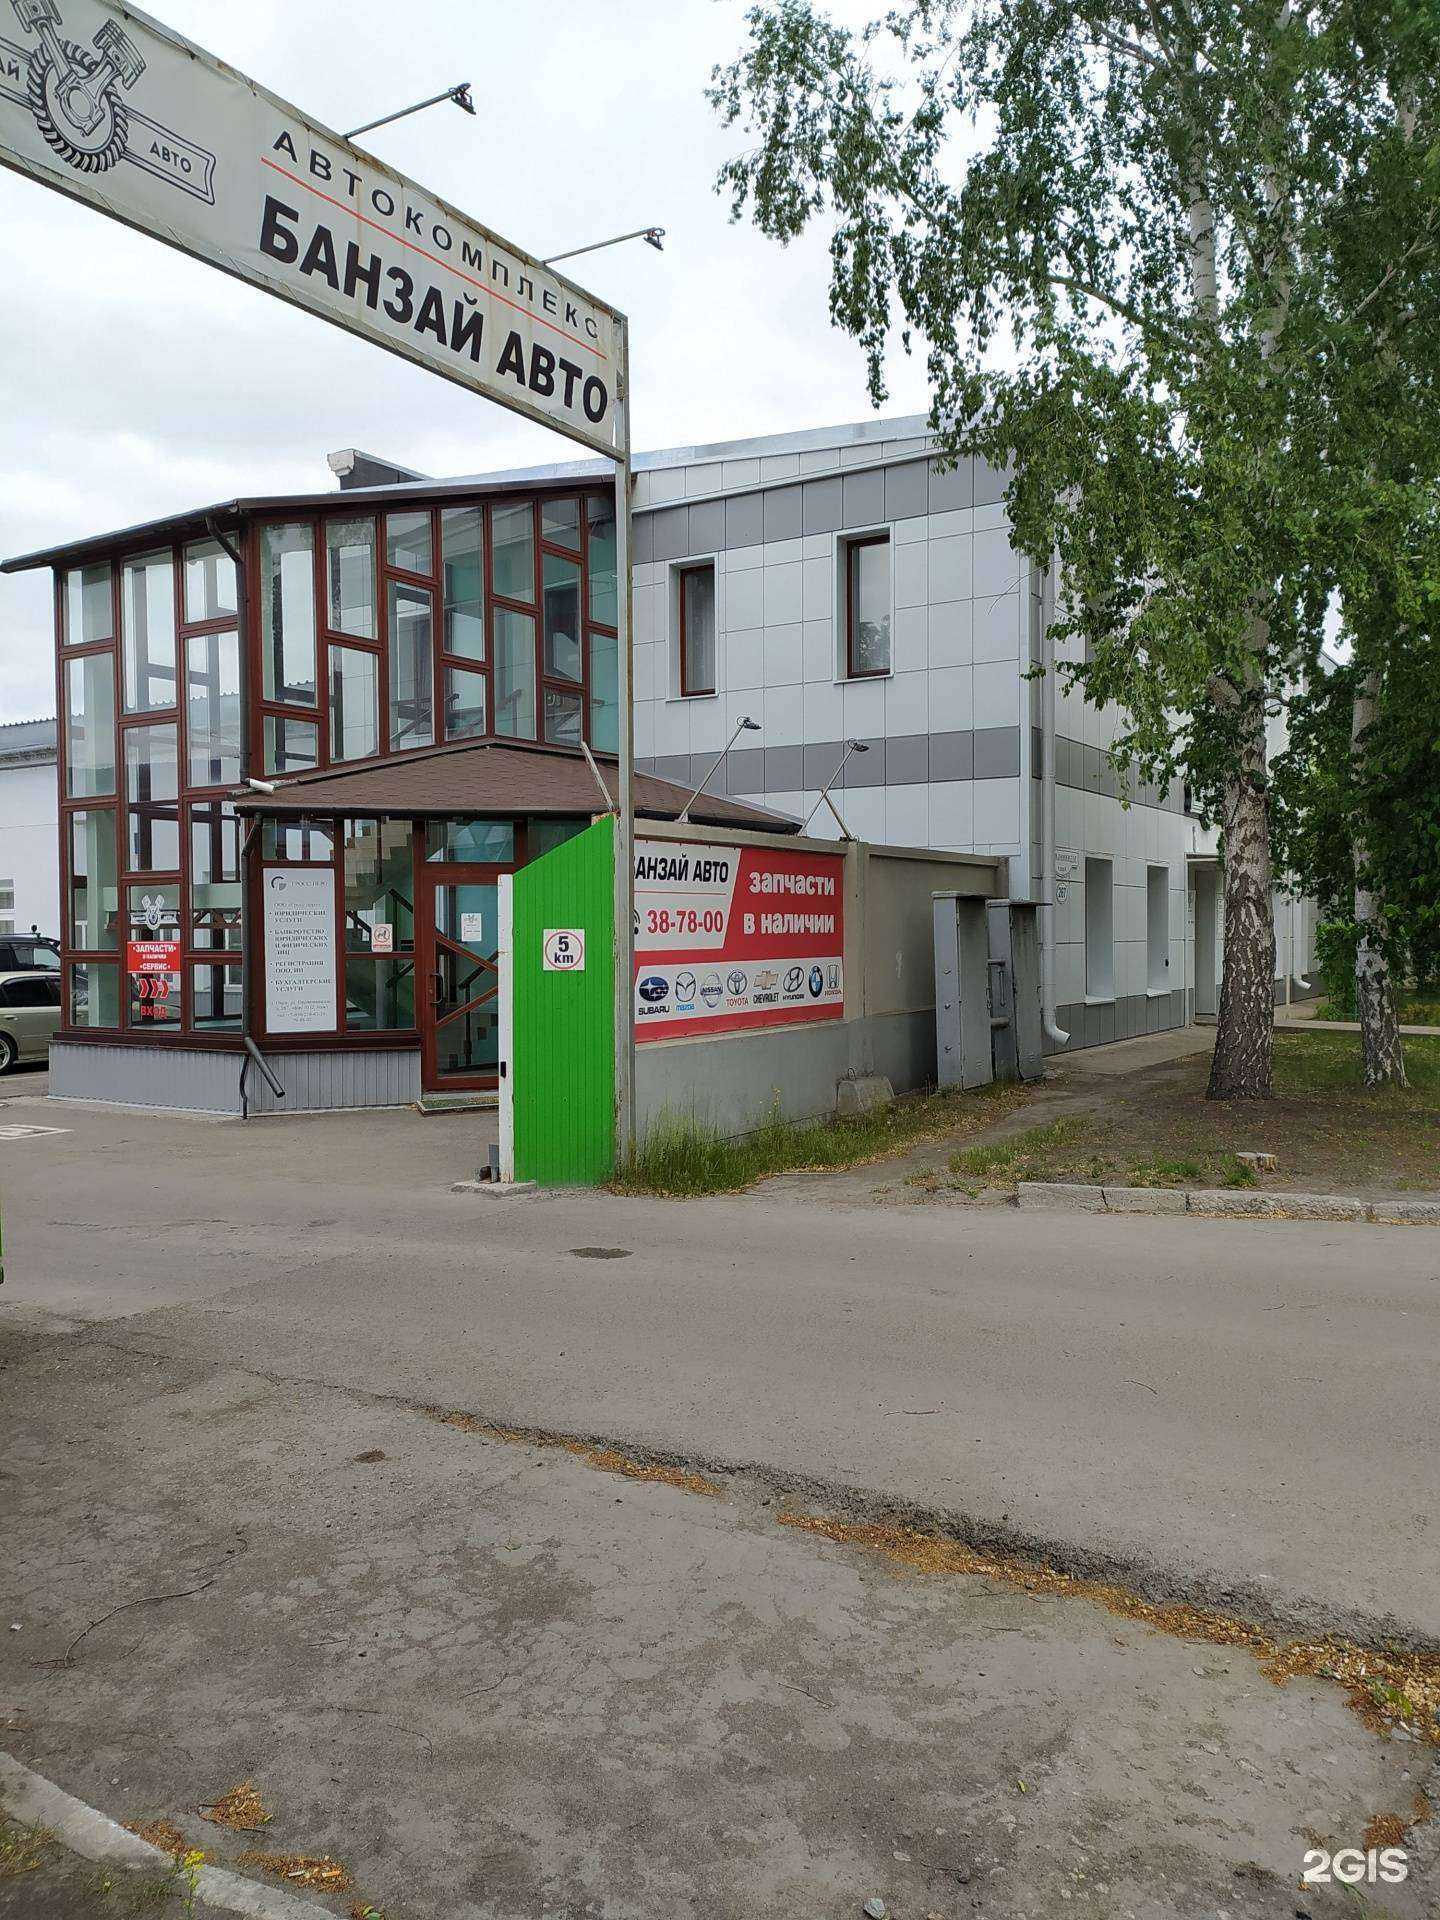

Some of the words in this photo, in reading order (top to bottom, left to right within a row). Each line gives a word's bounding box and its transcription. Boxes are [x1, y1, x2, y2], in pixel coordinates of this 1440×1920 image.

[149, 141, 192, 173] АВТО
[272, 129, 599, 339] АВТОКОМПЛЕКС
[259, 194, 483, 362] БАНЗАЙ
[495, 332, 608, 424] АВТО
[634, 853, 688, 882] АНЗАЙ
[692, 860, 729, 883] АВТО
[647, 909, 724, 934] 38-78-00
[743, 913, 756, 935] в
[760, 913, 835, 934] наличии
[135, 944, 174, 953] ЗАПЧАСТИ
[558, 935, 570, 953] 5
[753, 992, 780, 1005] CHEVROLET
[825, 988, 842, 997] HONDA
[638, 1004, 671, 1016] SUBARU
[726, 997, 749, 1008] TOYOTA
[141, 1005, 168, 1019] ВХОД
